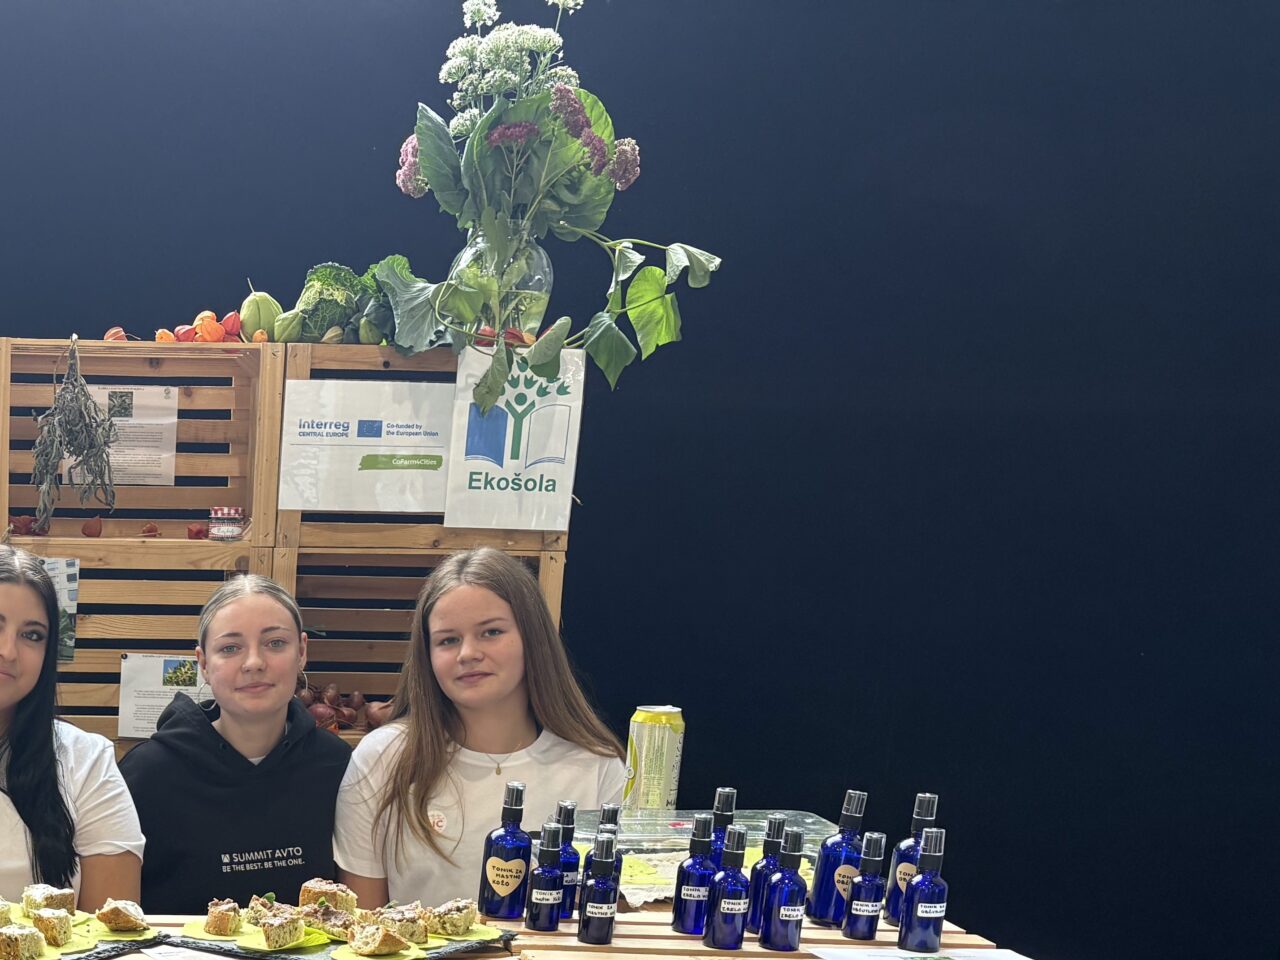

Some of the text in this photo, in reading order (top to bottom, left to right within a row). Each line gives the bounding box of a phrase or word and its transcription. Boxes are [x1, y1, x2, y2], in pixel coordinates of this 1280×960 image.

[468, 471, 557, 493] Ekošola
[232, 847, 302, 862] SUMMIT AVTO
[492, 866, 513, 874] TONIK
